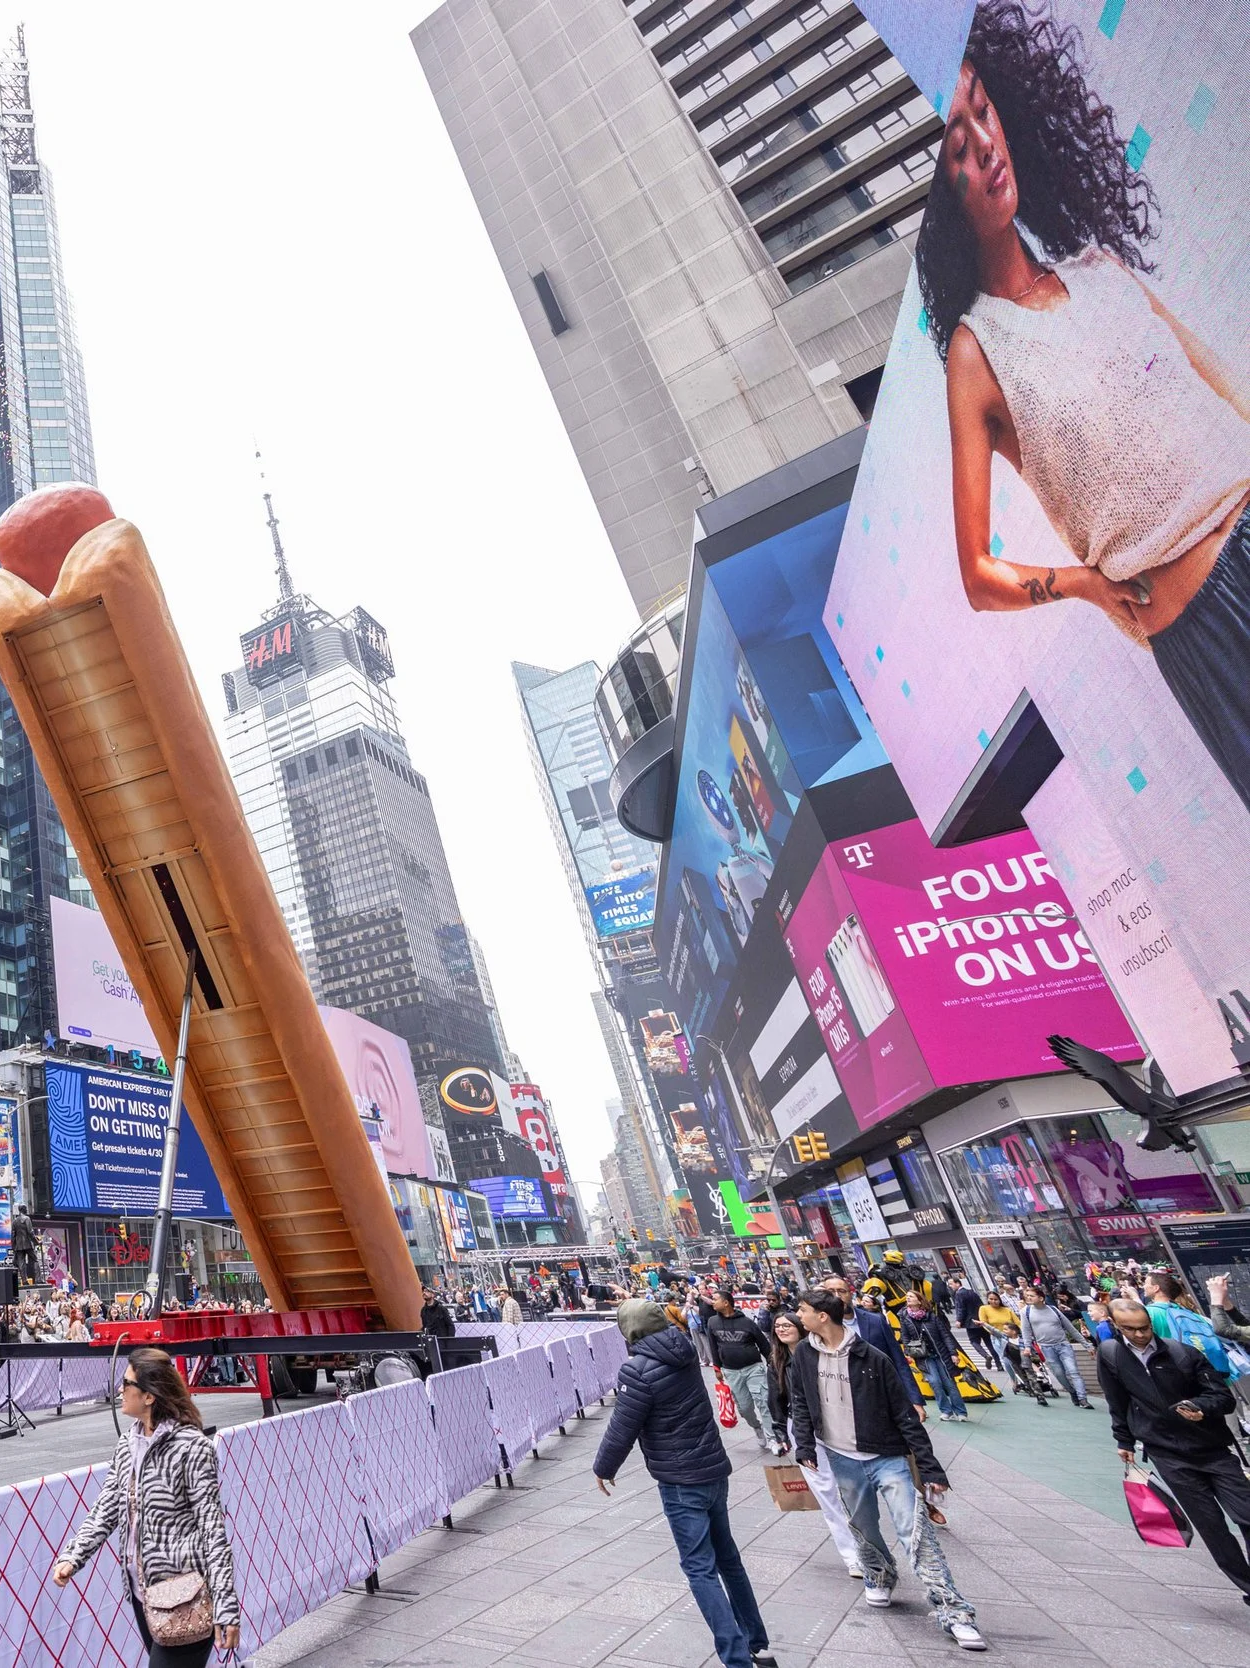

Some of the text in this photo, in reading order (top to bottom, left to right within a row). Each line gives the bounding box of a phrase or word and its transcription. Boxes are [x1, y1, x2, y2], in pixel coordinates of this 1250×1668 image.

[248, 622, 291, 672] H&M
[922, 851, 1058, 910] FOUR
[615, 890, 645, 904] INTO
[1087, 888, 1112, 916] shop
[601, 904, 639, 919] TIMES
[1117, 899, 1153, 933] & eas
[92, 960, 110, 978] Get
[955, 943, 1037, 987] ON
[102, 979, 128, 1000] Cash
[808, 966, 828, 1001] FOUR
[942, 998, 960, 1008] With
[985, 991, 997, 1000] bill
[997, 986, 1024, 998] credits
[1024, 984, 1039, 994] and
[1046, 978, 1074, 989] eligible
[981, 981, 1106, 1009] For well-qualified customers; plus
[815, 986, 843, 1031] iPhone 15
[778, 1055, 799, 1083] SEPHORA
[87, 1076, 169, 1097] AMERICAN EARLY
[128, 1099, 157, 1118] MISS
[90, 1116, 162, 1139] ON GETTING
[91, 1141, 163, 1158] Get presale tickets 4/30
[896, 1135, 913, 1149] SEPHORA
[93, 1162, 105, 1170] Visit
[104, 1163, 145, 1175] Ticketmaster.com
[913, 1207, 947, 1227] SEPHORA
[818, 1370, 837, 1380] alvin
